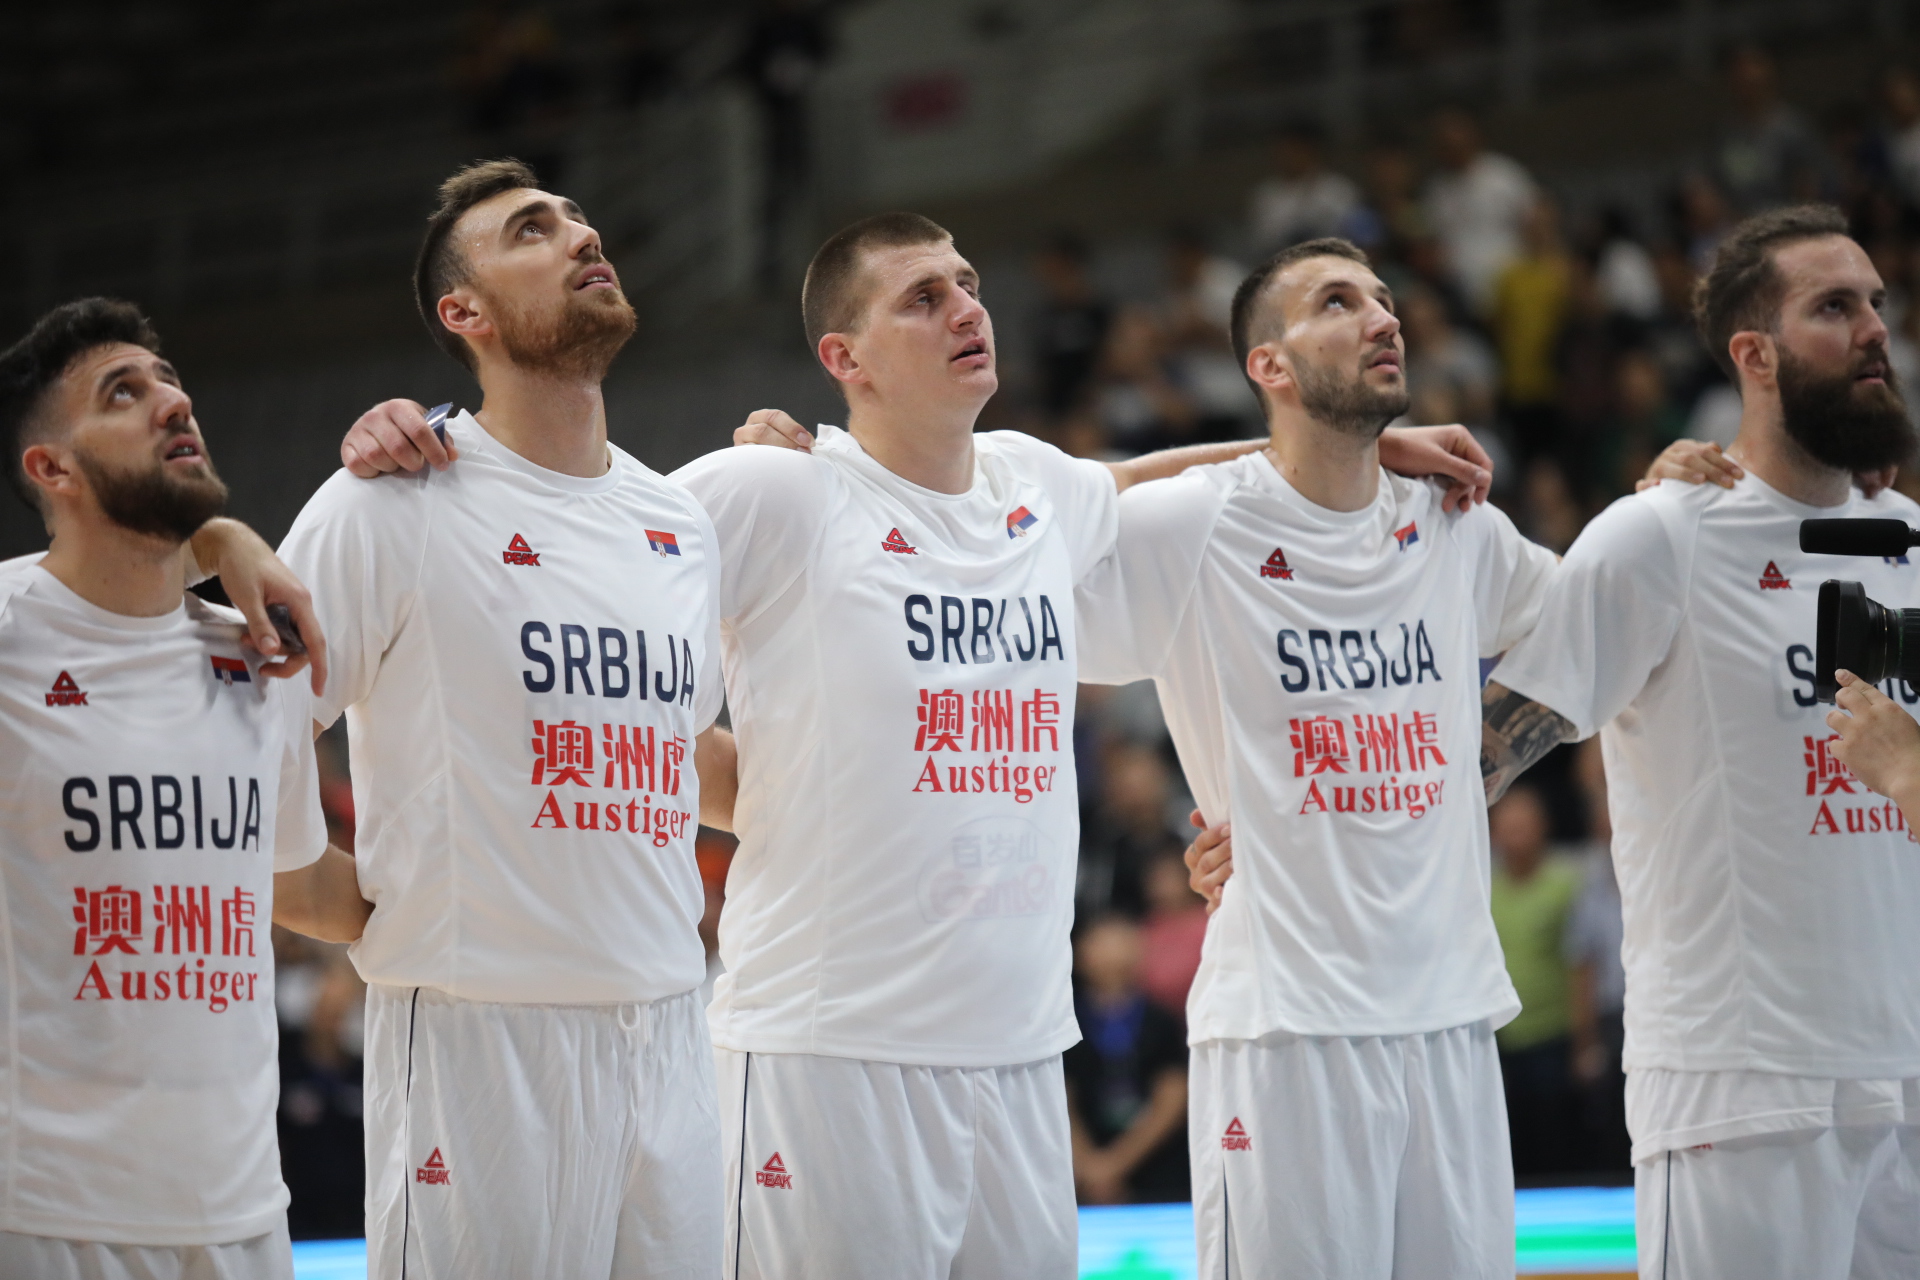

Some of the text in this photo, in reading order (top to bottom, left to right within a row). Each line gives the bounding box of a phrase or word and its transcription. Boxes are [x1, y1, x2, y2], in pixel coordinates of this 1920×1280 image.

[503, 551, 541, 566] PEAK
[1260, 565, 1294, 580] PEAK
[904, 594, 1064, 664] SRBIJA
[1276, 619, 1442, 693] SRBIJA
[520, 620, 695, 710] SRBIJA
[45, 691, 88, 707] PEAK
[913, 688, 1060, 753] 澳洲虎
[531, 719, 687, 796] 澳洲虎
[1288, 711, 1448, 778] 澳洲虎
[912, 755, 1057, 804] Austiger
[1298, 778, 1444, 819] Austiger
[61, 774, 261, 853] SRBIJA
[530, 789, 691, 848] Austiger
[73, 885, 256, 957] 澳洲虎
[74, 959, 257, 1014] Austiger
[1221, 1136, 1252, 1151] PEAK
[416, 1167, 451, 1185] PEAK
[756, 1170, 793, 1190] PEAK
